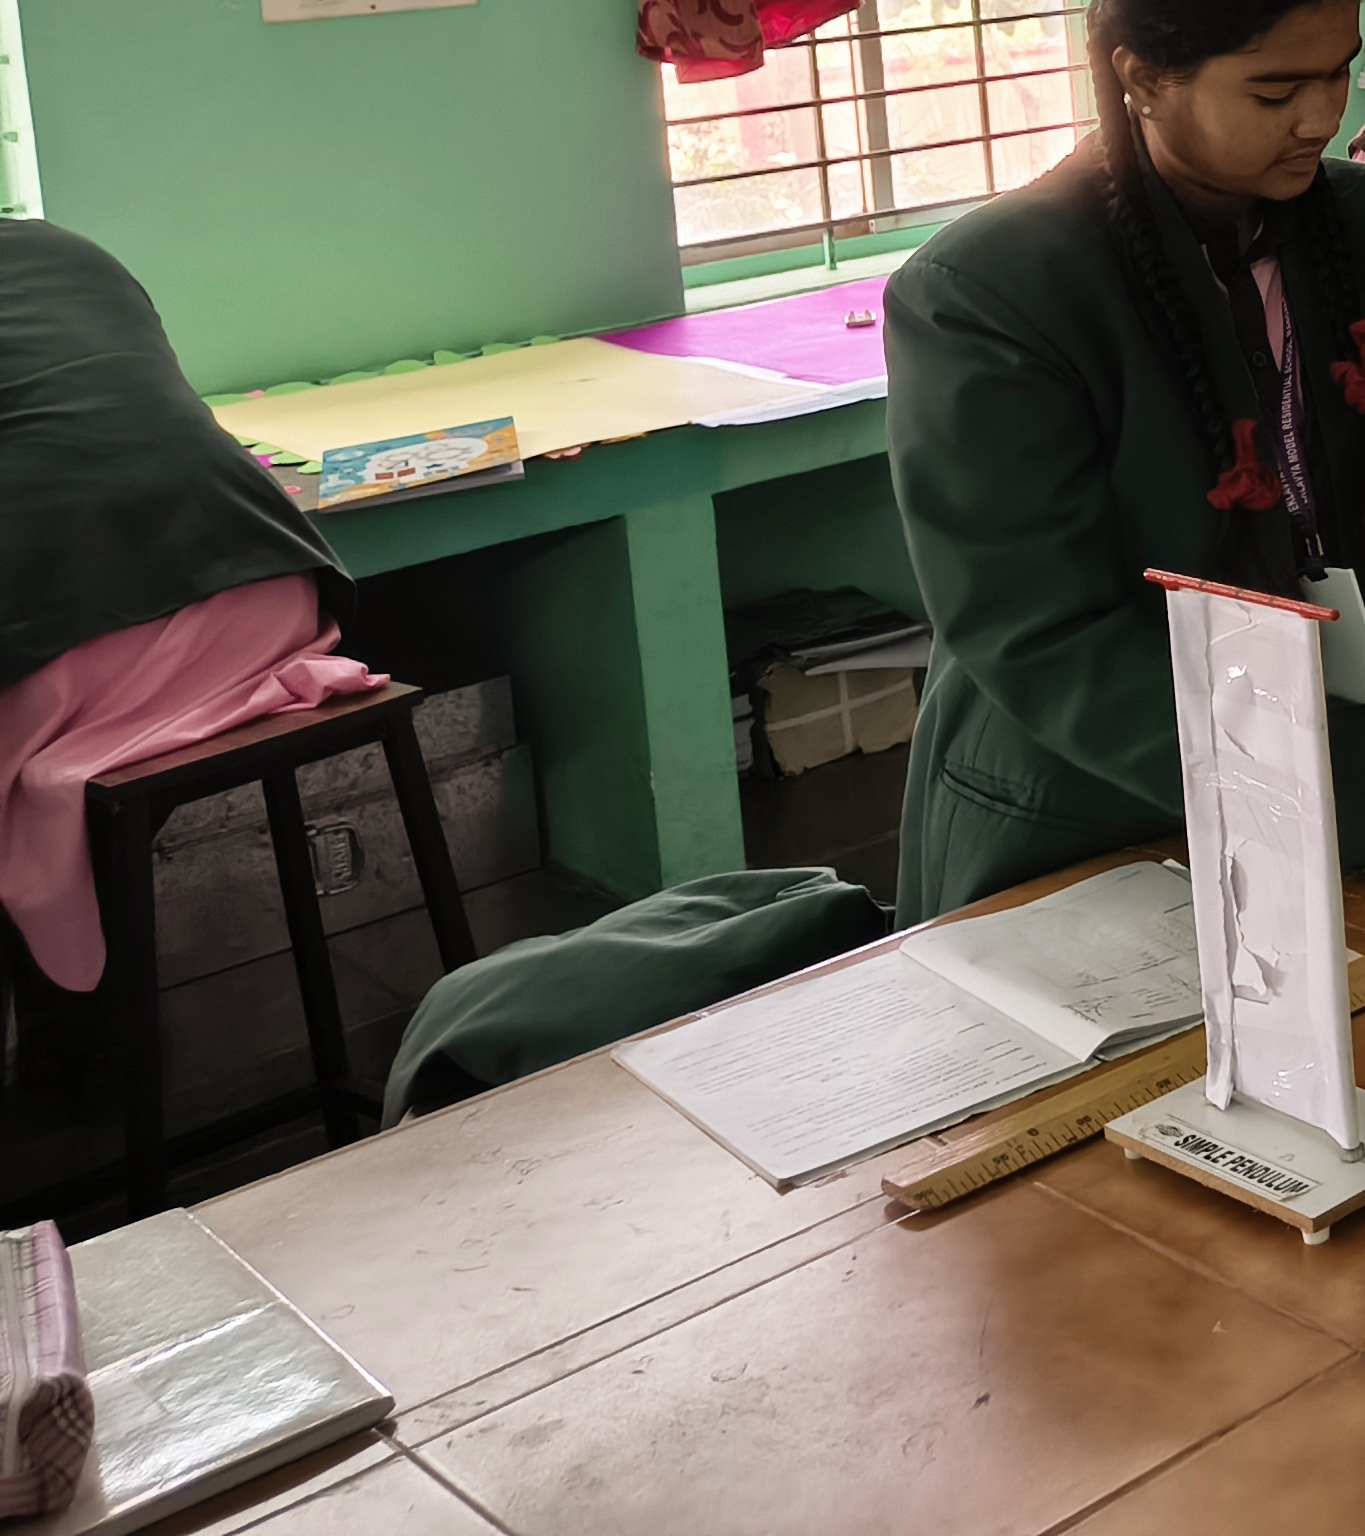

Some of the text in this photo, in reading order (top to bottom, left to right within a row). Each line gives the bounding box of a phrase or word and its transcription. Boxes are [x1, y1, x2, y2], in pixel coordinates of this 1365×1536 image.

[1282, 374, 1293, 431] RESIDENTIAL
[1284, 431, 1299, 463] MODEL
[1174, 1133, 1310, 1194] SIMPLE PENDULUM
